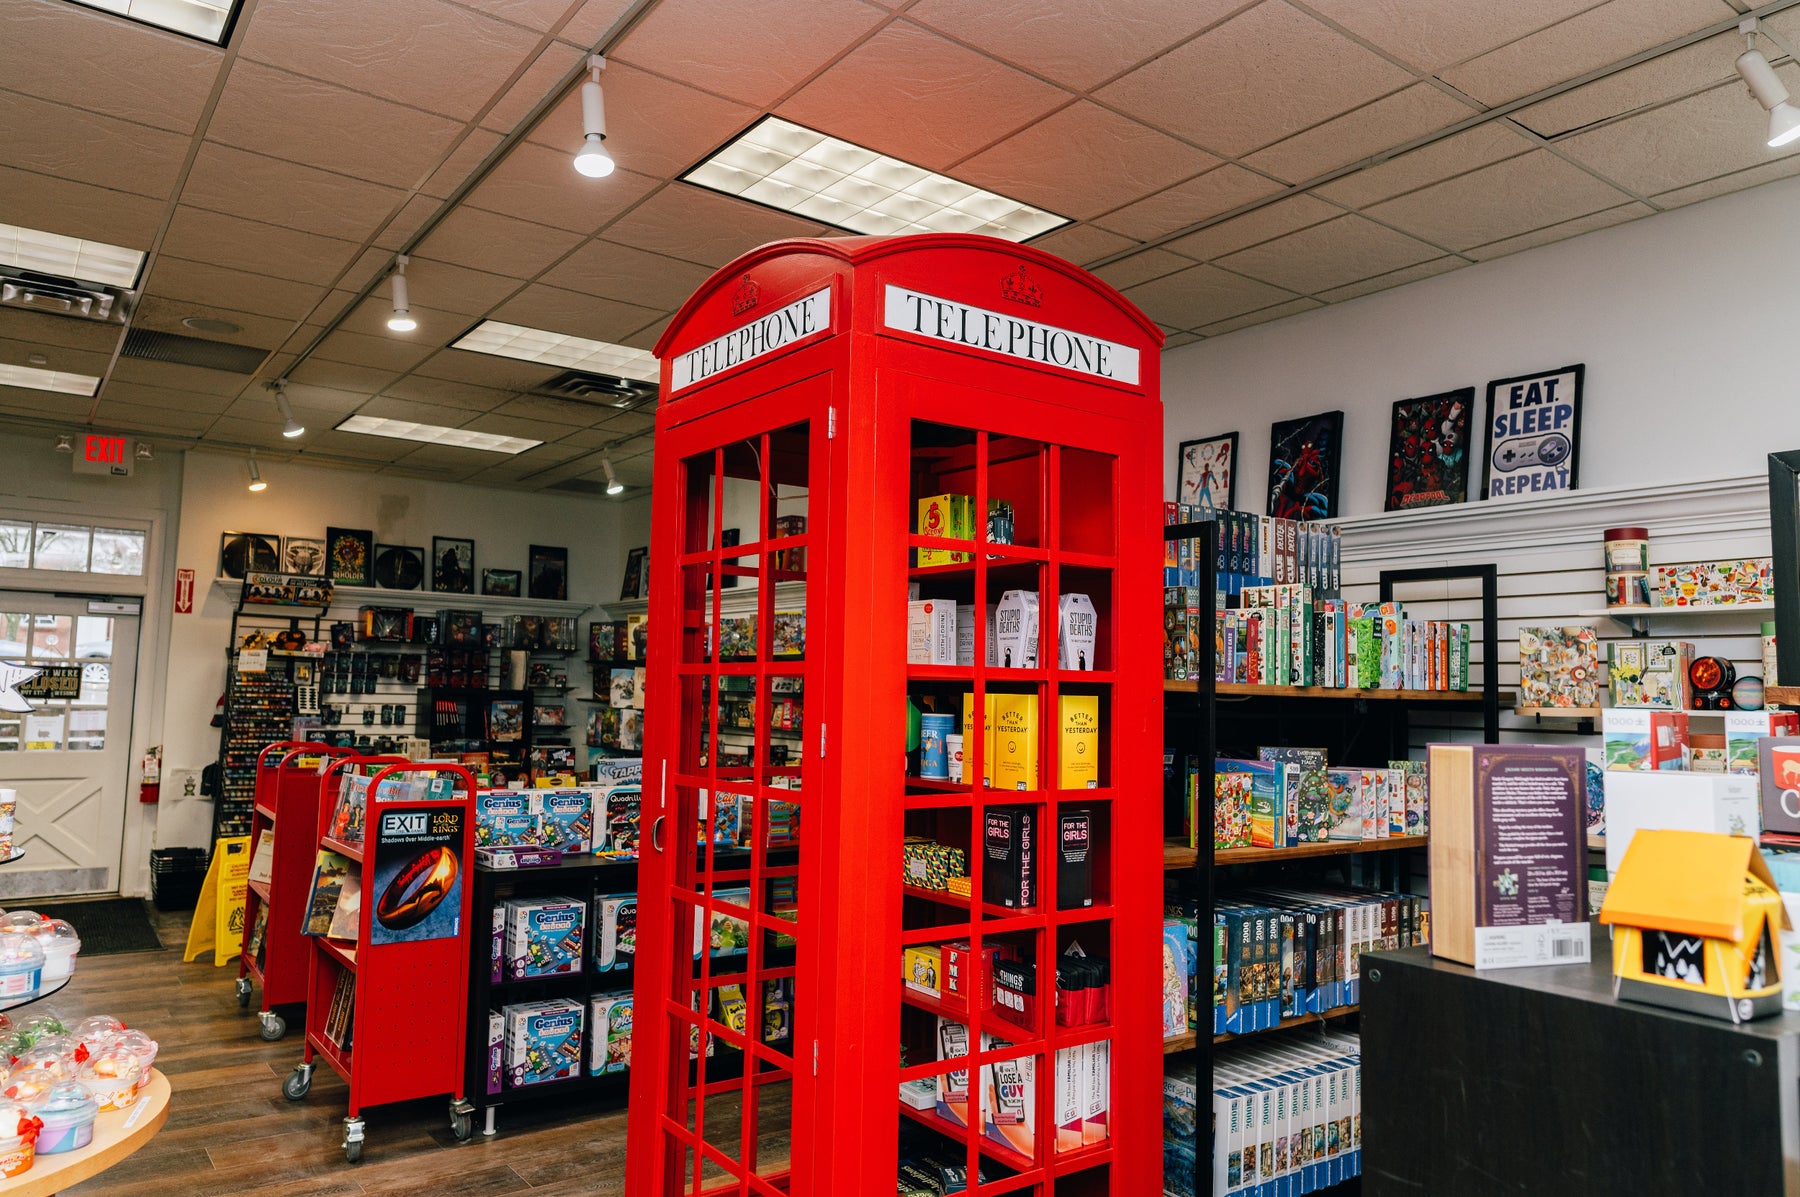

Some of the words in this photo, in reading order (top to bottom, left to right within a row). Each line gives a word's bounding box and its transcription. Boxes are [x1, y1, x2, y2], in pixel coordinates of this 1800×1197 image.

[687, 297, 815, 384] TELEPHONE
[907, 294, 1113, 377] TELEPHONE
[1509, 378, 1559, 409] EAT.
[1494, 404, 1573, 439] SLEEP.
[85, 435, 127, 464] EXIT
[1490, 469, 1571, 497] REPEAT.
[1401, 490, 1449, 505] DEADPOOL
[1275, 524, 1285, 551] DEXTER
[1285, 525, 1295, 552] DEXTER
[1276, 554, 1285, 583] CLUE
[1286, 555, 1295, 584] CLUE
[1000, 608, 1020, 622] STUPID
[1069, 612, 1092, 625] STUPID
[999, 621, 1020, 634] DEATHS
[1069, 624, 1093, 637] DEATHS
[1001, 711, 1024, 721] BETTER
[1069, 712, 1094, 722] BETTER
[997, 726, 1028, 734] YESTERDAY
[484, 797, 522, 808] Genius
[550, 797, 585, 807] Genius
[384, 815, 425, 833] EXIT
[433, 814, 459, 824] LORD
[506, 817, 530, 825] Genius
[987, 818, 998, 827] FOR
[999, 820, 1009, 828] THE
[1076, 821, 1087, 829] THE
[432, 825, 458, 834] RINGS
[987, 827, 1010, 839] GIRLS
[1022, 815, 1030, 850] GIRLS
[1063, 830, 1088, 841] GIRLS
[417, 834, 450, 842] Middle-earth
[1022, 851, 1030, 876] THE
[1021, 879, 1030, 906] FOR
[535, 912, 575, 924] Genius
[1243, 921, 1251, 944] 2000
[1256, 919, 1264, 942] 2000
[1270, 918, 1278, 940] 2000
[950, 951, 958, 964] F
[949, 964, 959, 978] M
[999, 969, 1023, 987] THINGS
[949, 978, 958, 991] K
[534, 1016, 573, 1030] Genius
[1000, 1073, 1017, 1084] LOSE
[1017, 1073, 1023, 1082] A
[1001, 1085, 1024, 1098] GUY
